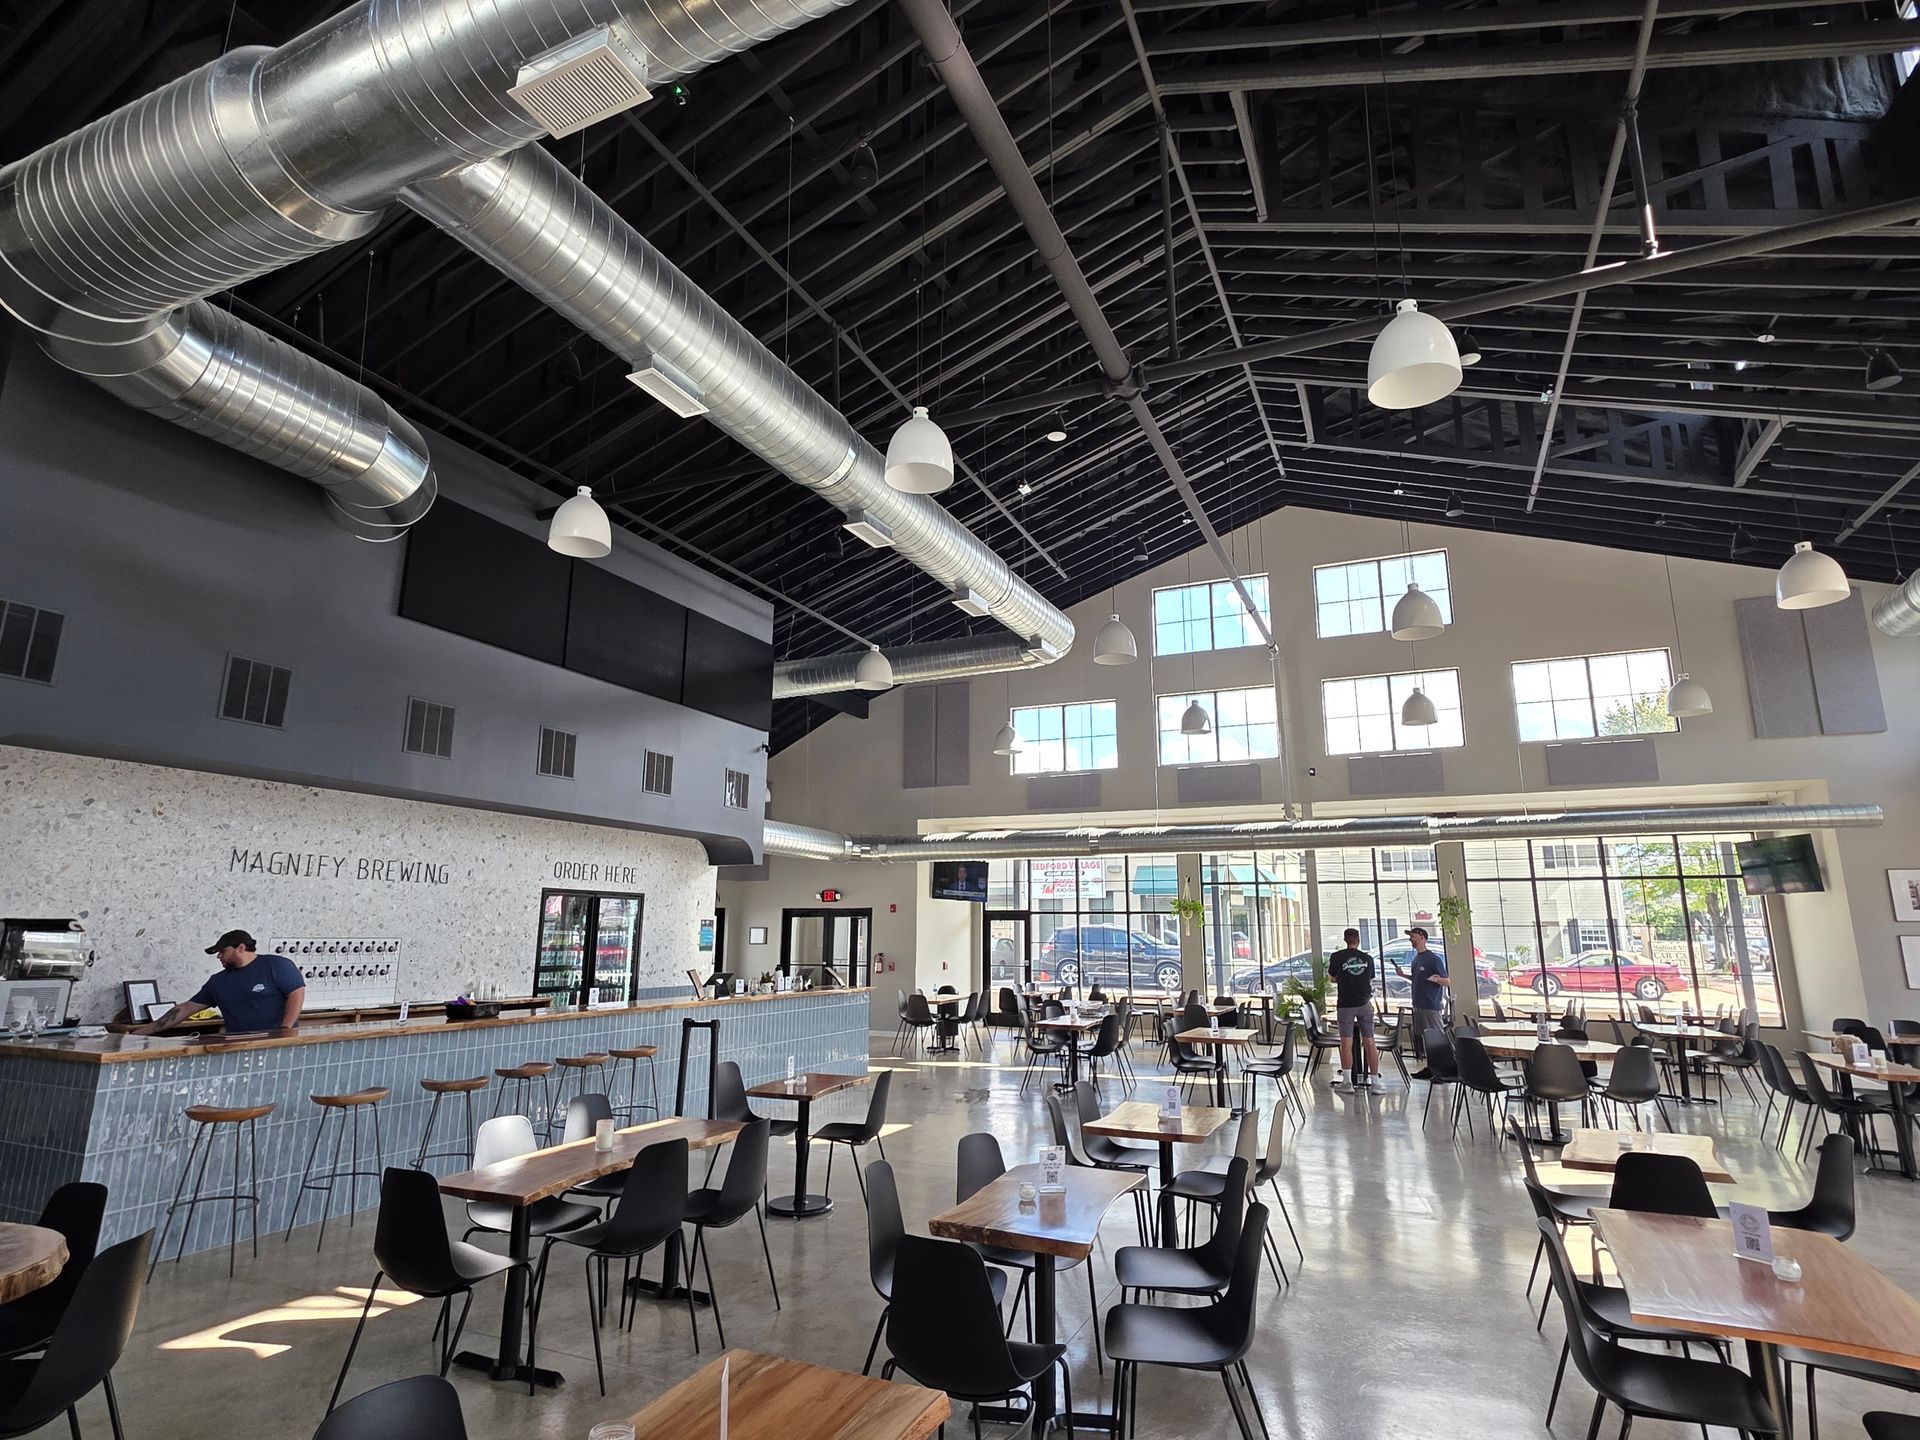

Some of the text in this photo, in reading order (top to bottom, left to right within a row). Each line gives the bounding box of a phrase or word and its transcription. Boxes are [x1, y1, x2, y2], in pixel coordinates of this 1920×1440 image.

[229, 848, 449, 885] MAGNIFY BREWING
[553, 861, 637, 885] ORDER HERE
[1069, 861, 1100, 869] VLAGE
